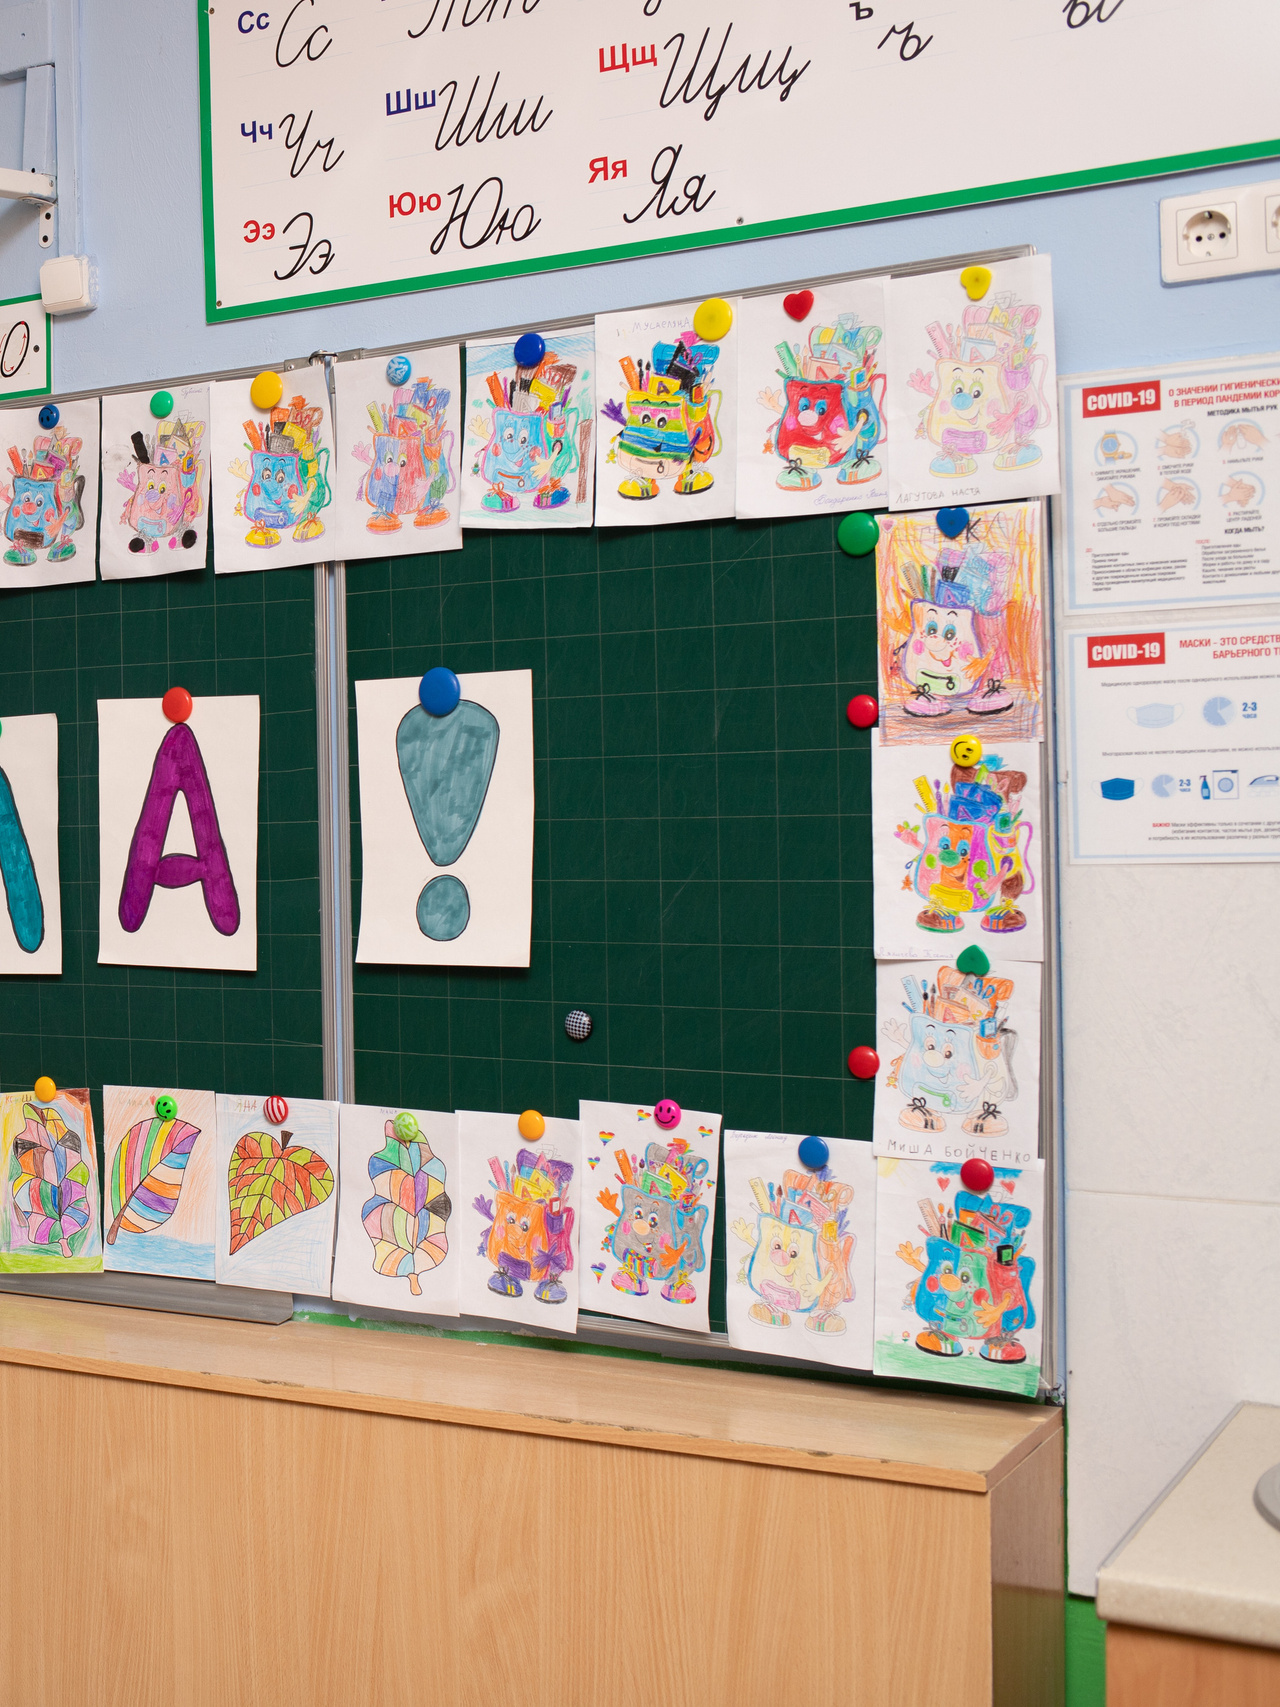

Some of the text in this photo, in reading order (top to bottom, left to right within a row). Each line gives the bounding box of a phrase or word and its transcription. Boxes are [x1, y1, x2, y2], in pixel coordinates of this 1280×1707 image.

[237, 10, 270, 34] Сс
[598, 22, 811, 121] Щщ Щщ
[385, 71, 553, 151] Шш Шш
[240, 109, 345, 178] Чч Чч
[588, 144, 716, 224] Яя Яя
[389, 176, 542, 255] Юю Юю
[242, 211, 335, 280] Ээ Ээ
[0, 321, 30, 378] 0
[1087, 388, 1156, 411] COVID-19
[1176, 384, 1218, 397] ЗНАЧЕНИИ
[1181, 396, 1214, 408] ПЕРИОД
[1216, 391, 1262, 404] ПАНДЕМИИ
[1207, 408, 1240, 417] МЕТОДИКА
[1241, 405, 1264, 414] МЫТЬЯ
[952, 488, 981, 497] НАСТЯ
[1092, 642, 1160, 661] COVID-19
[1179, 638, 1211, 649] МАСКИ
[1219, 637, 1237, 647] ЭТО
[1212, 650, 1271, 660] БАРЬЕРНОГО
[1242, 702, 1257, 712] 2-3
[1179, 779, 1191, 787] 2-3
[944, 1143, 1031, 1165] БОЙЧЕНКО
